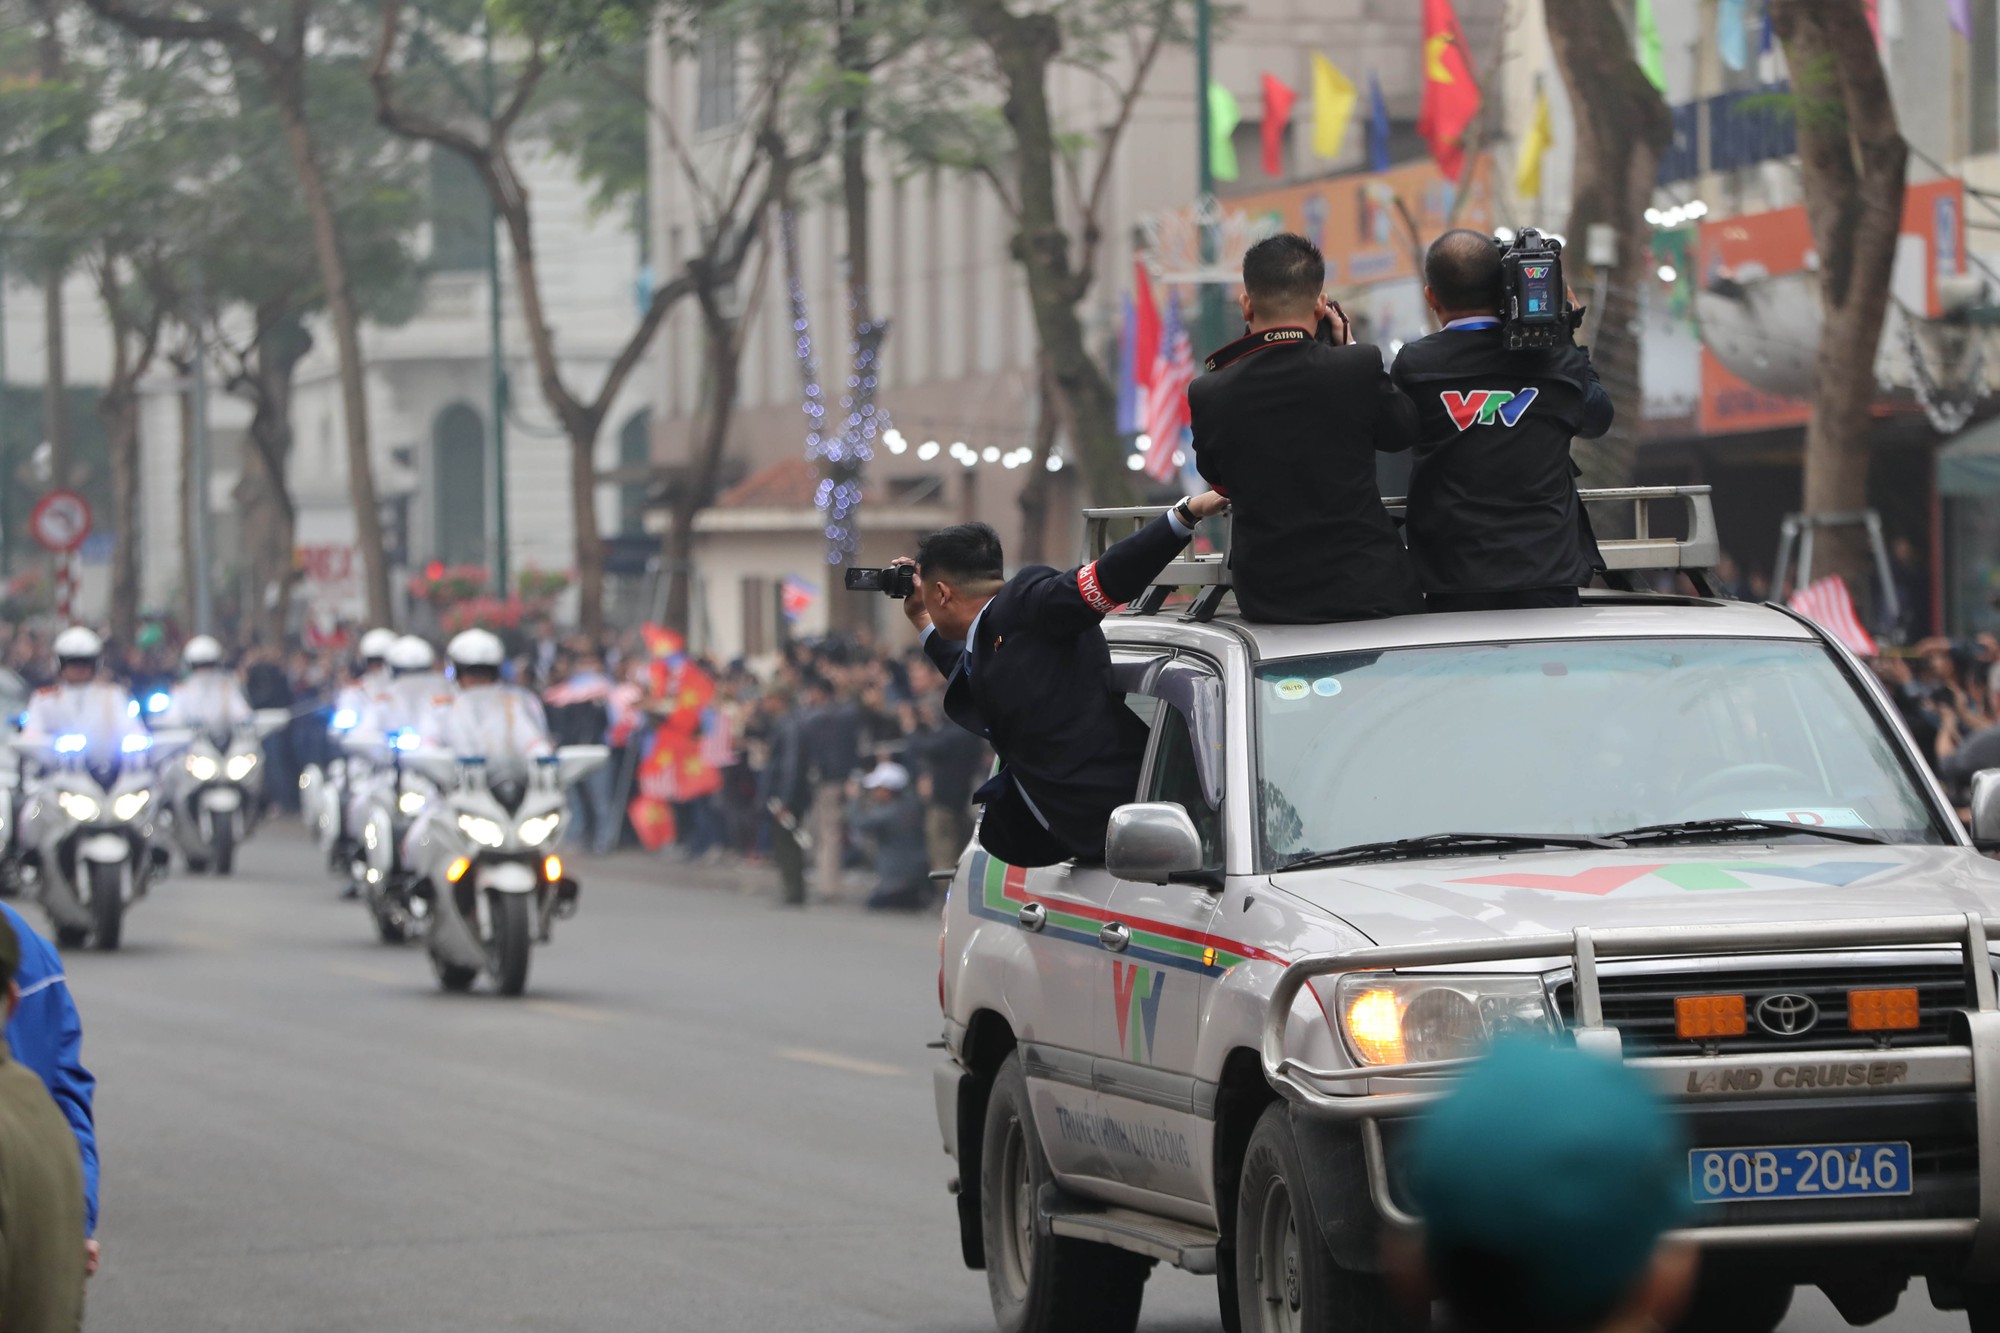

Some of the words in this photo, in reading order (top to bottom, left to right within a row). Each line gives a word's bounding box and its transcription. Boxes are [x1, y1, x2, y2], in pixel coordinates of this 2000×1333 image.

[1524, 267, 1549, 278] VTV
[1264, 331, 1304, 342] Canon
[1440, 387, 1539, 432] VTV
[1113, 960, 1166, 1066] VTV
[1686, 1068, 1763, 1093] LAND
[1773, 1061, 1908, 1088] CRUISER
[1703, 1149, 1898, 1195] 80B-2046
